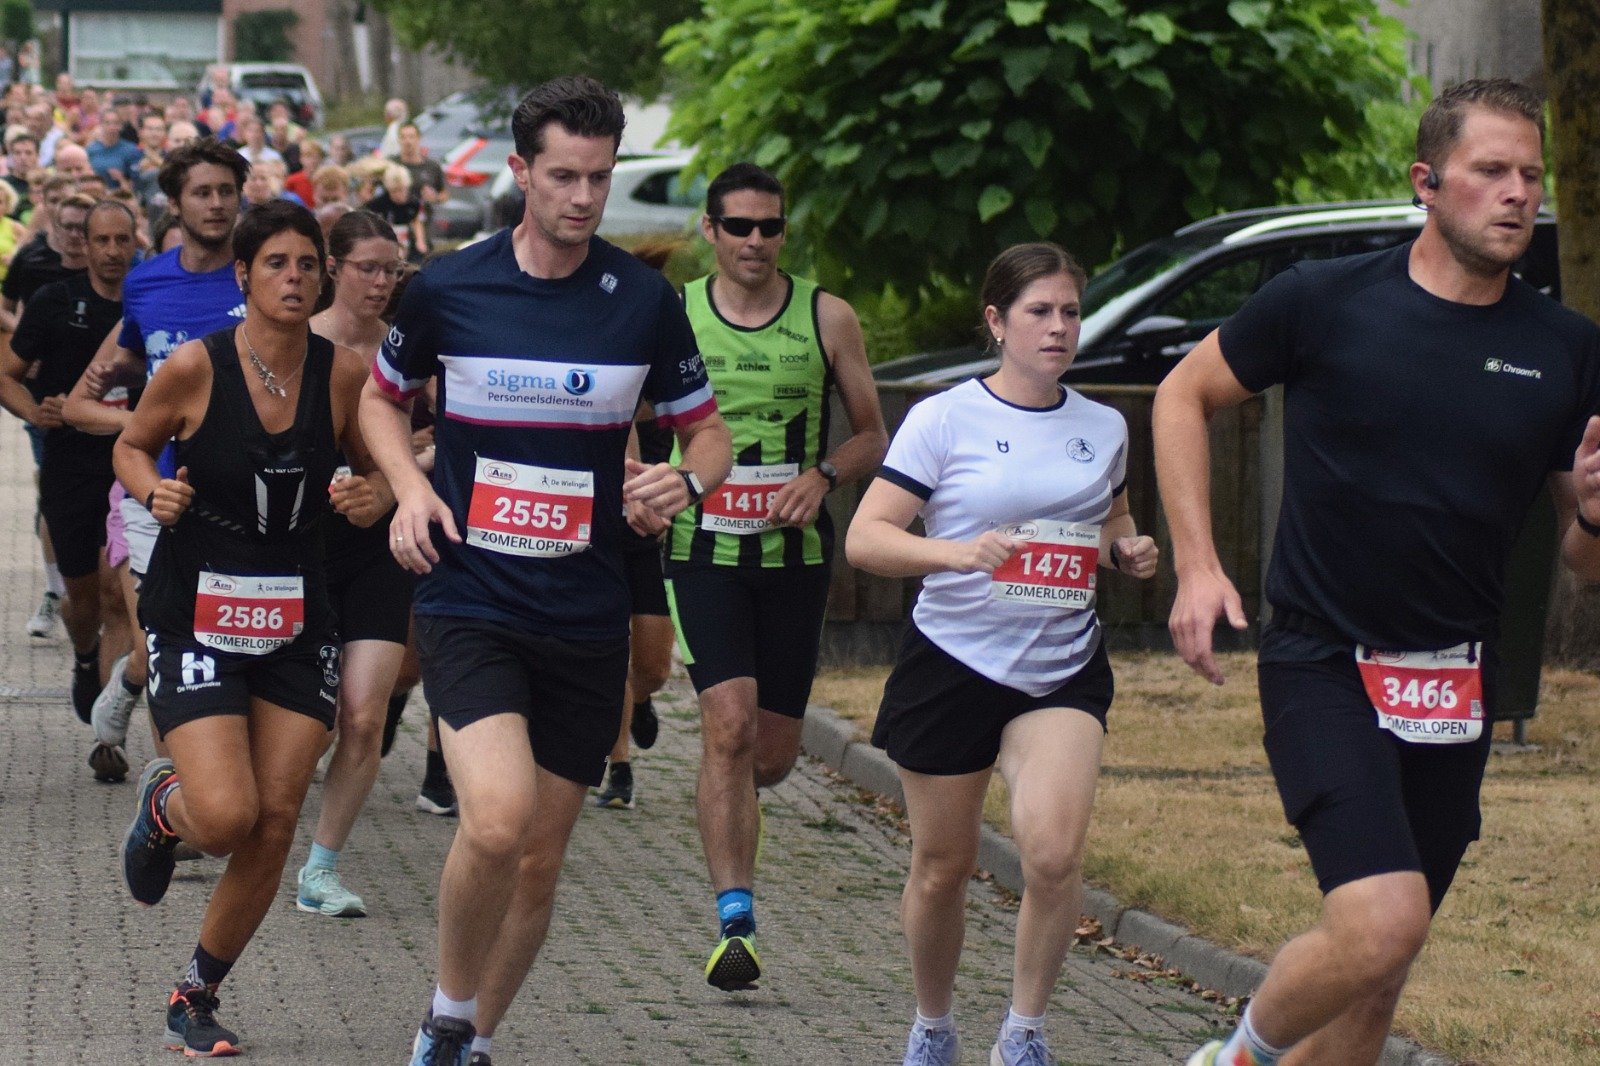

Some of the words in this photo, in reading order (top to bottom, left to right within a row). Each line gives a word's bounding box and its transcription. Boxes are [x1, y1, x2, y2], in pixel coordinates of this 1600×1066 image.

[487, 369, 557, 393] Sigma
[488, 392, 594, 408] Personeelsdiensten
[551, 478, 560, 486] De
[561, 480, 589, 489] Wielingen
[492, 496, 569, 530] 2555
[480, 530, 574, 553] ZOMERLOPEN
[1020, 551, 1082, 580] 1475
[1005, 584, 1087, 602] ZOMERLOPEN
[216, 604, 283, 630] 2586
[206, 634, 289, 650] ZOMERLOPEN
[1382, 676, 1458, 709] 3466
[1386, 716, 1468, 735] OMERLOPEN
